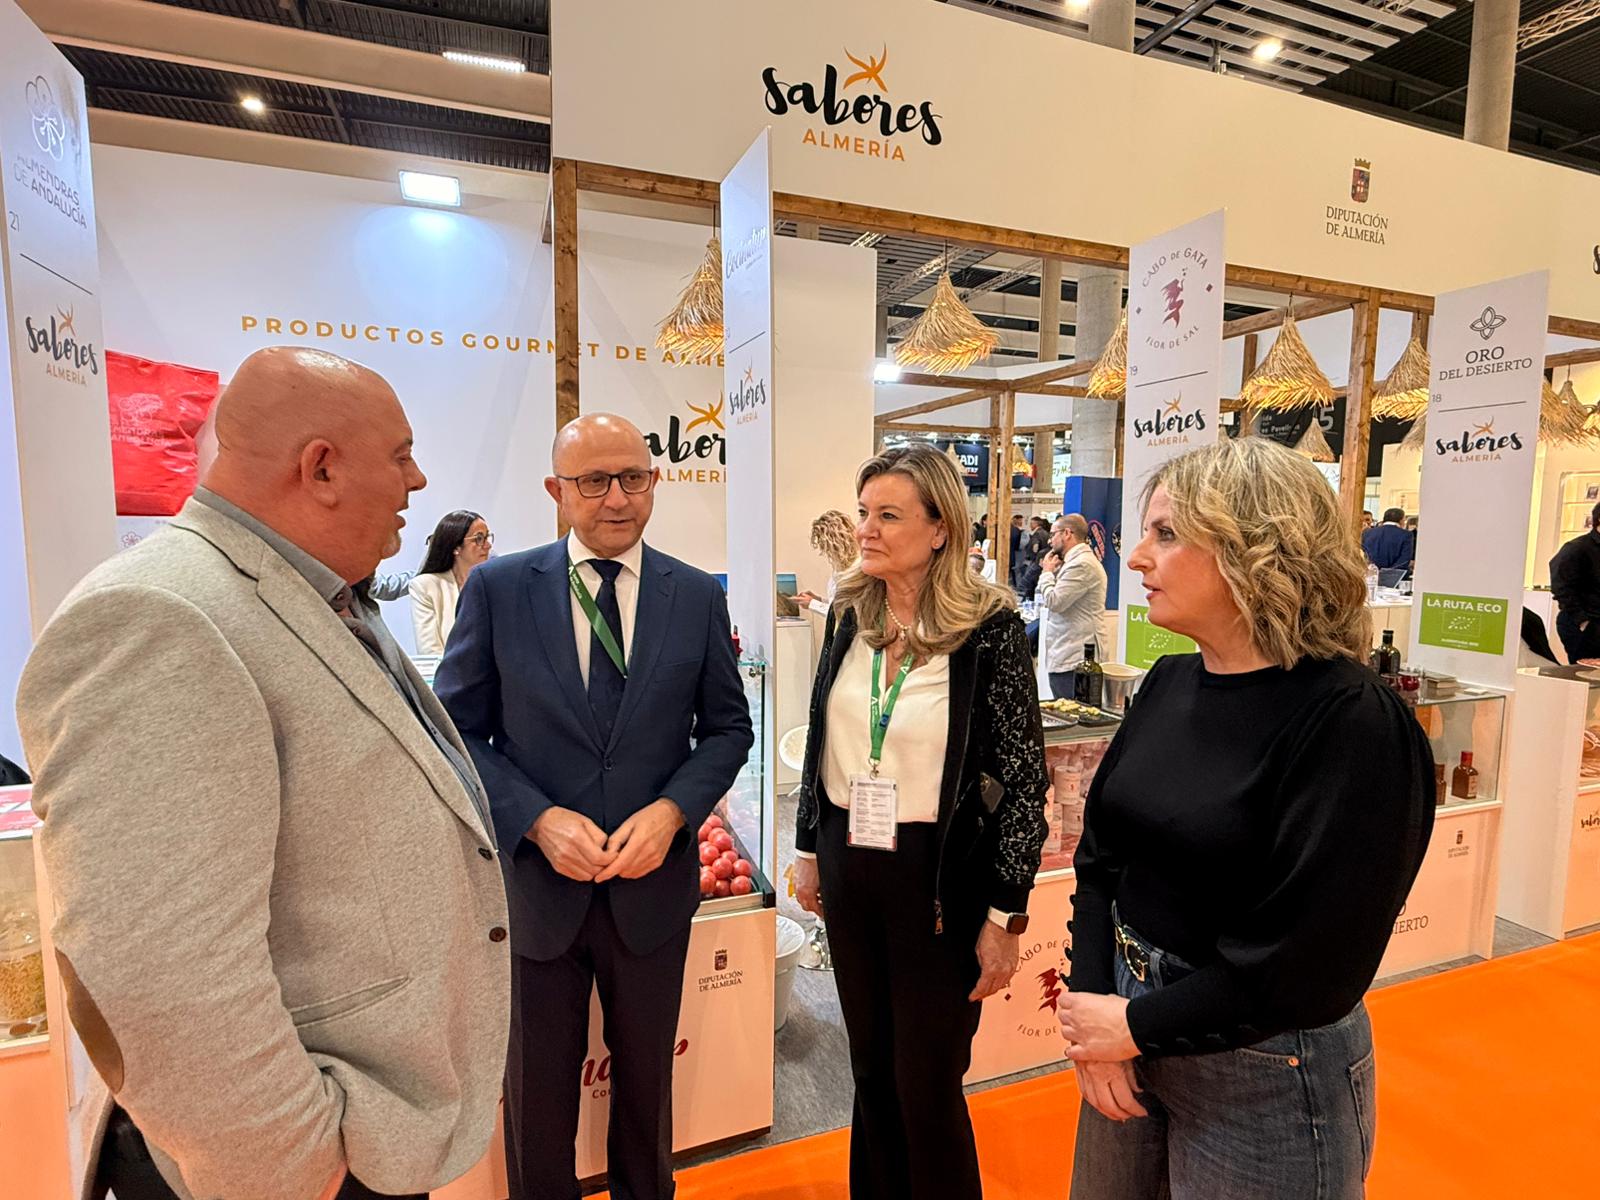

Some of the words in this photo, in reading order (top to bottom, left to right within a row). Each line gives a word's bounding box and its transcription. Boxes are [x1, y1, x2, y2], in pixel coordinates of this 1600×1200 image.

[802, 128, 905, 162] ALMERÍA
[17, 153, 80, 206] ALMENDRAS
[31, 177, 88, 230] ANDALUCÍA
[8, 210, 20, 232] 21
[1326, 205, 1389, 230] DIPUTACIÓN
[1326, 221, 1340, 237] DE
[1341, 225, 1385, 245] ALMERÍA
[1142, 255, 1167, 287] CABO
[1170, 250, 1181, 261] DE
[1183, 247, 1208, 269] GATA
[241, 315, 444, 346] PRODUCTOS
[616, 345, 647, 361] DE
[1145, 336, 1166, 350] FLOR
[1168, 337, 1180, 350] DE
[1183, 325, 1200, 342] SAL
[1465, 346, 1504, 364] ORO
[46, 363, 87, 388] ALMERÍA
[1129, 365, 1138, 376] 19
[1439, 368, 1464, 381] DEL
[1466, 357, 1533, 378] DESIERTO
[1432, 393, 1442, 403] 18
[1319, 405, 1335, 432] 5
[1147, 433, 1189, 447] ALMERÍA
[1451, 453, 1502, 463] ALMERÍA
[1427, 598, 1442, 608] LA
[1442, 599, 1474, 611] RUTA
[1476, 602, 1502, 614] ECO
[1130, 612, 1143, 622] LA
[1394, 914, 1429, 934] IERTO
[1047, 940, 1058, 949] DE
[698, 969, 744, 985] DIPUTACIÓN
[699, 984, 709, 992] DE
[710, 978, 742, 990] ALMERÍA
[1016, 1023, 1040, 1037] FLOR
[1045, 1026, 1057, 1037] DE
